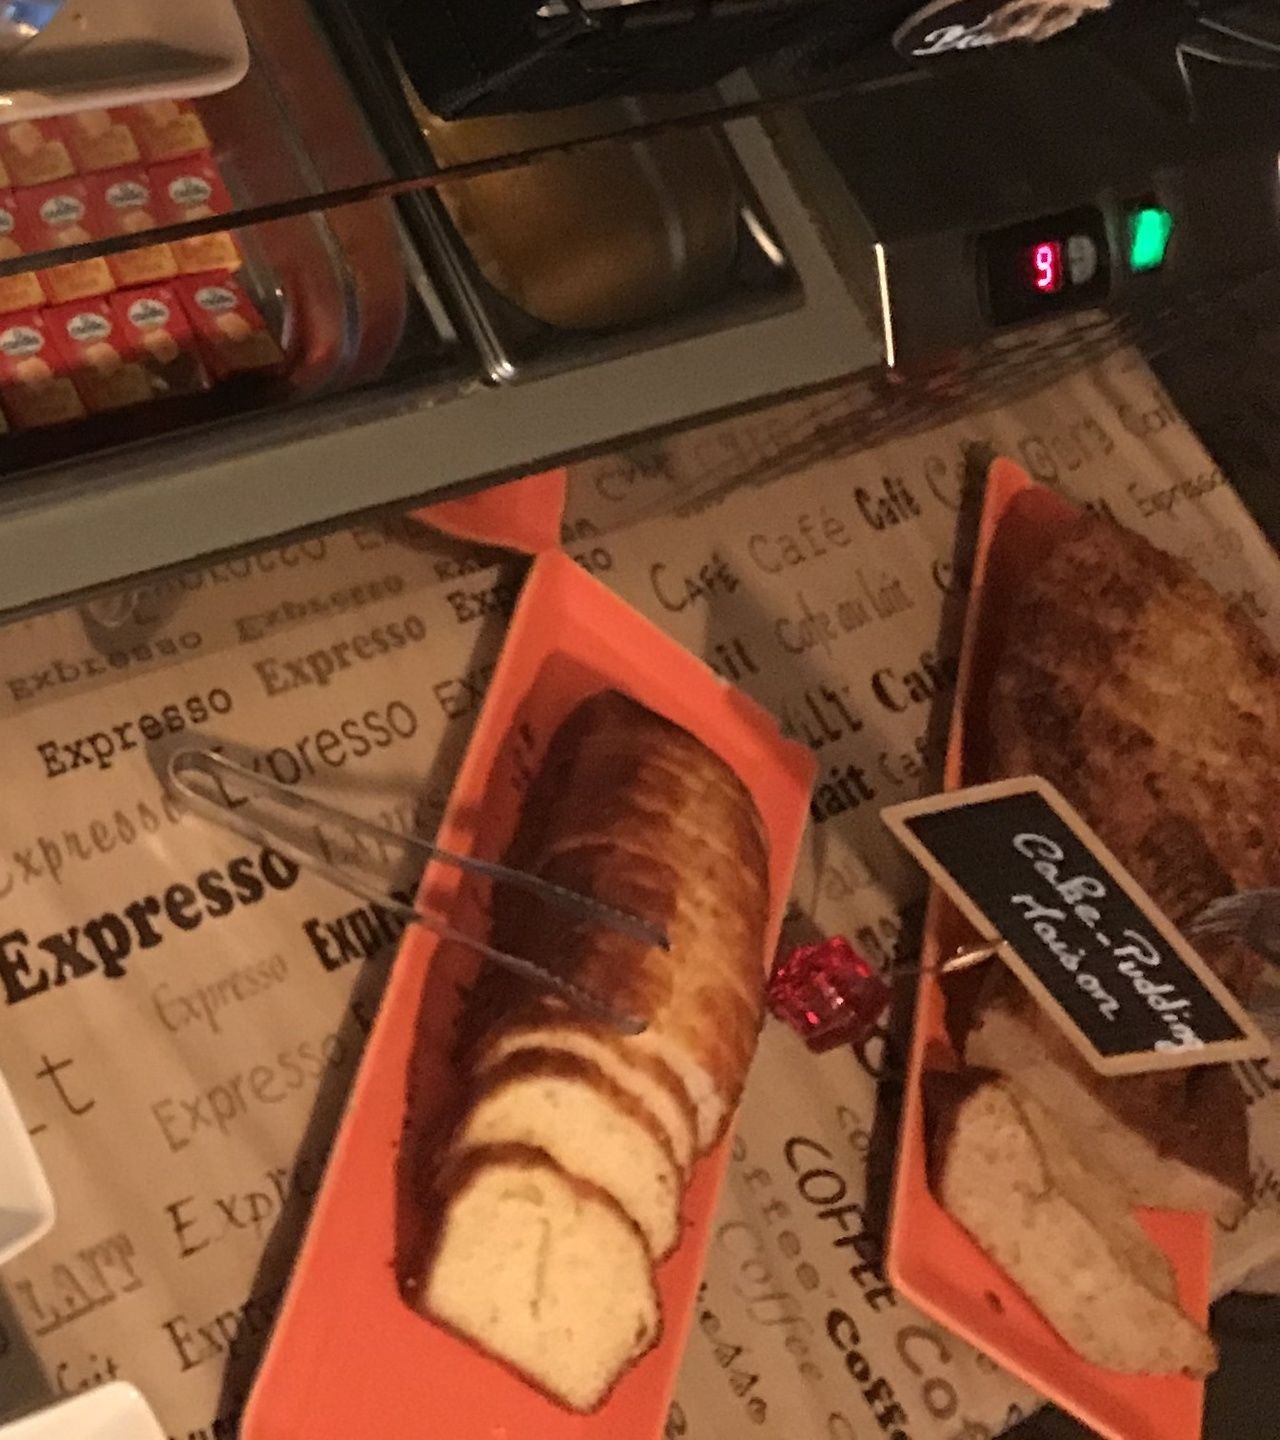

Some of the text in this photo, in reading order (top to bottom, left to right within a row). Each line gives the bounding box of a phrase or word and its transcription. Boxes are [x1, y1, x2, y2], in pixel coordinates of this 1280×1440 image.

[252, 613, 428, 699] Expresso
[37, 687, 234, 779] Expresso
[206, 700, 418, 810] Epresso
